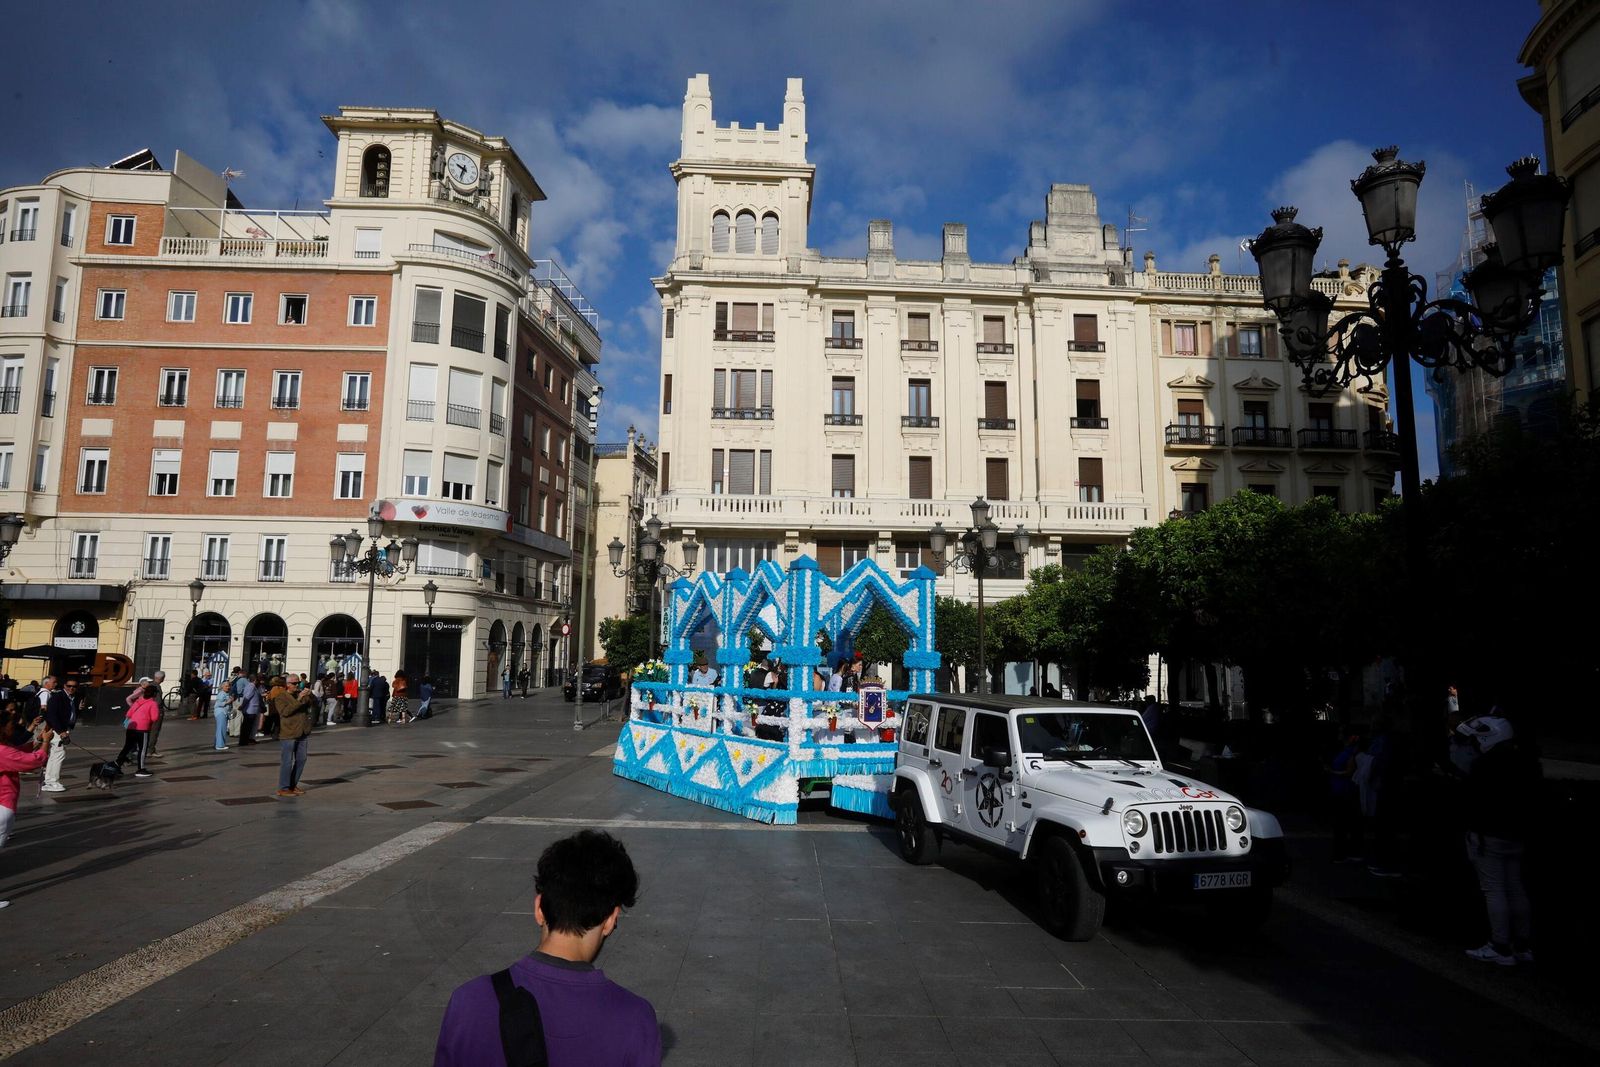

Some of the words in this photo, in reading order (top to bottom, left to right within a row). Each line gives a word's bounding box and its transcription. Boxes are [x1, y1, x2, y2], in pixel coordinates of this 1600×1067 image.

[435, 505, 456, 515] Valle
[458, 508, 469, 516] de
[1200, 874, 1226, 887] 6778
[1229, 873, 1249, 886] KGR
